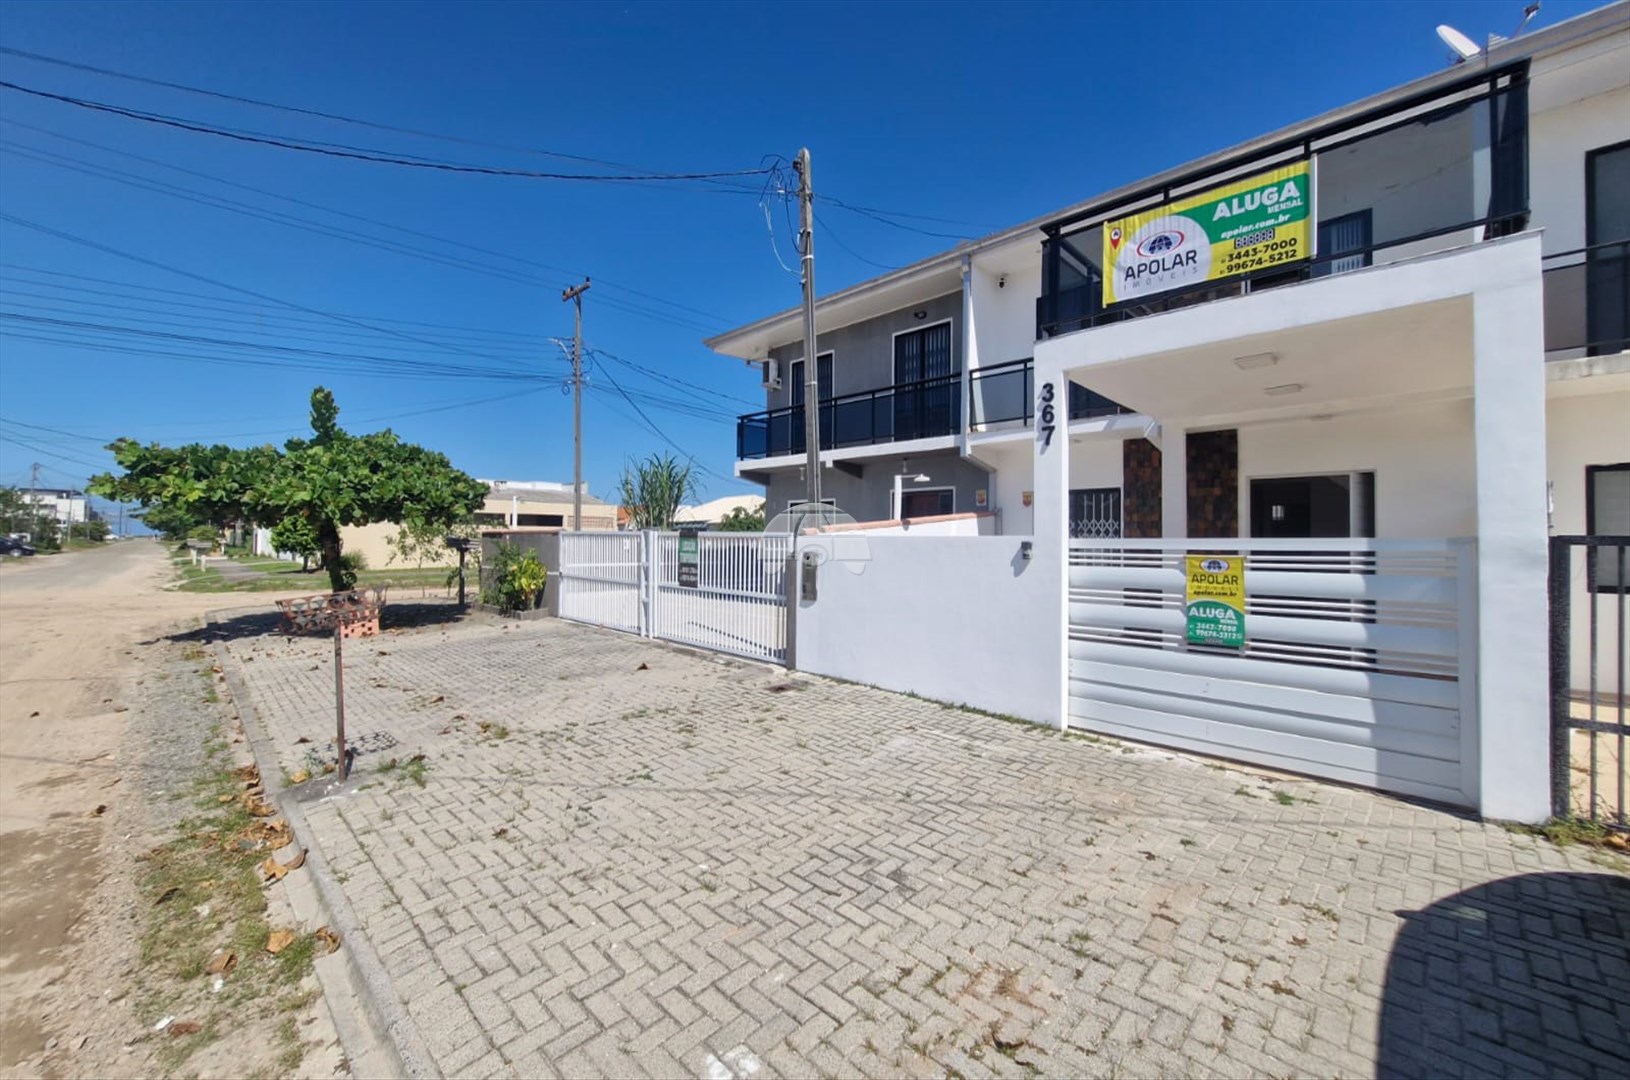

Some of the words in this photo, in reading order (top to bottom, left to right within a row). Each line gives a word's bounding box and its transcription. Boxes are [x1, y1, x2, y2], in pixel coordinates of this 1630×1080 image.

[1212, 180, 1300, 221] ALUGA
[1267, 198, 1304, 214] MENSAL
[1220, 214, 1291, 240] apolar.com.br
[1226, 249, 1297, 274] 99674-5212
[1227, 237, 1298, 263] 3443-7000
[1124, 249, 1198, 281] APOLAR
[1041, 382, 1055, 447] 367
[1191, 574, 1239, 586] APOLAR
[1188, 606, 1236, 620] ALUGA
